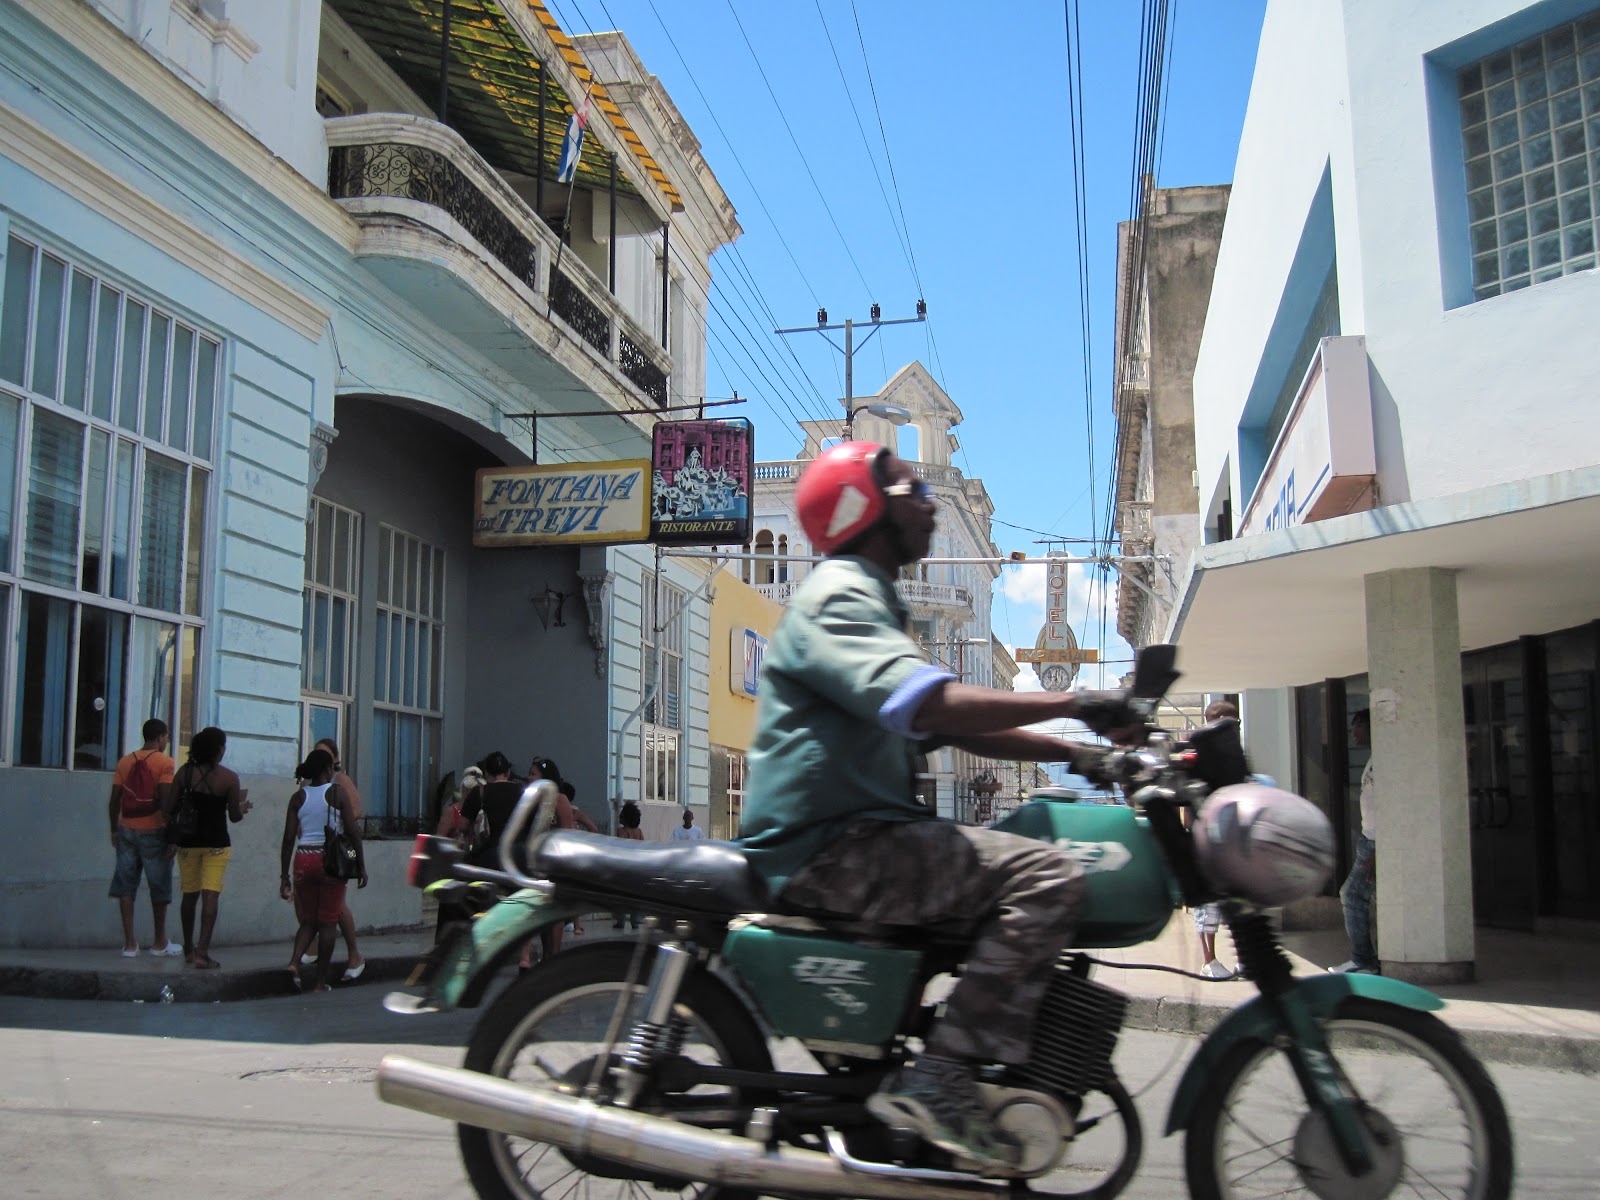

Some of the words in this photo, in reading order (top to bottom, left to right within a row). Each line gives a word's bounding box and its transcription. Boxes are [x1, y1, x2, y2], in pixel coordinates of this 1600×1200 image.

[485, 472, 640, 507] FONTANA
[495, 506, 608, 535] TREVI
[659, 520, 736, 533] RISTORANTE
[1049, 559, 1065, 640] HOTEL
